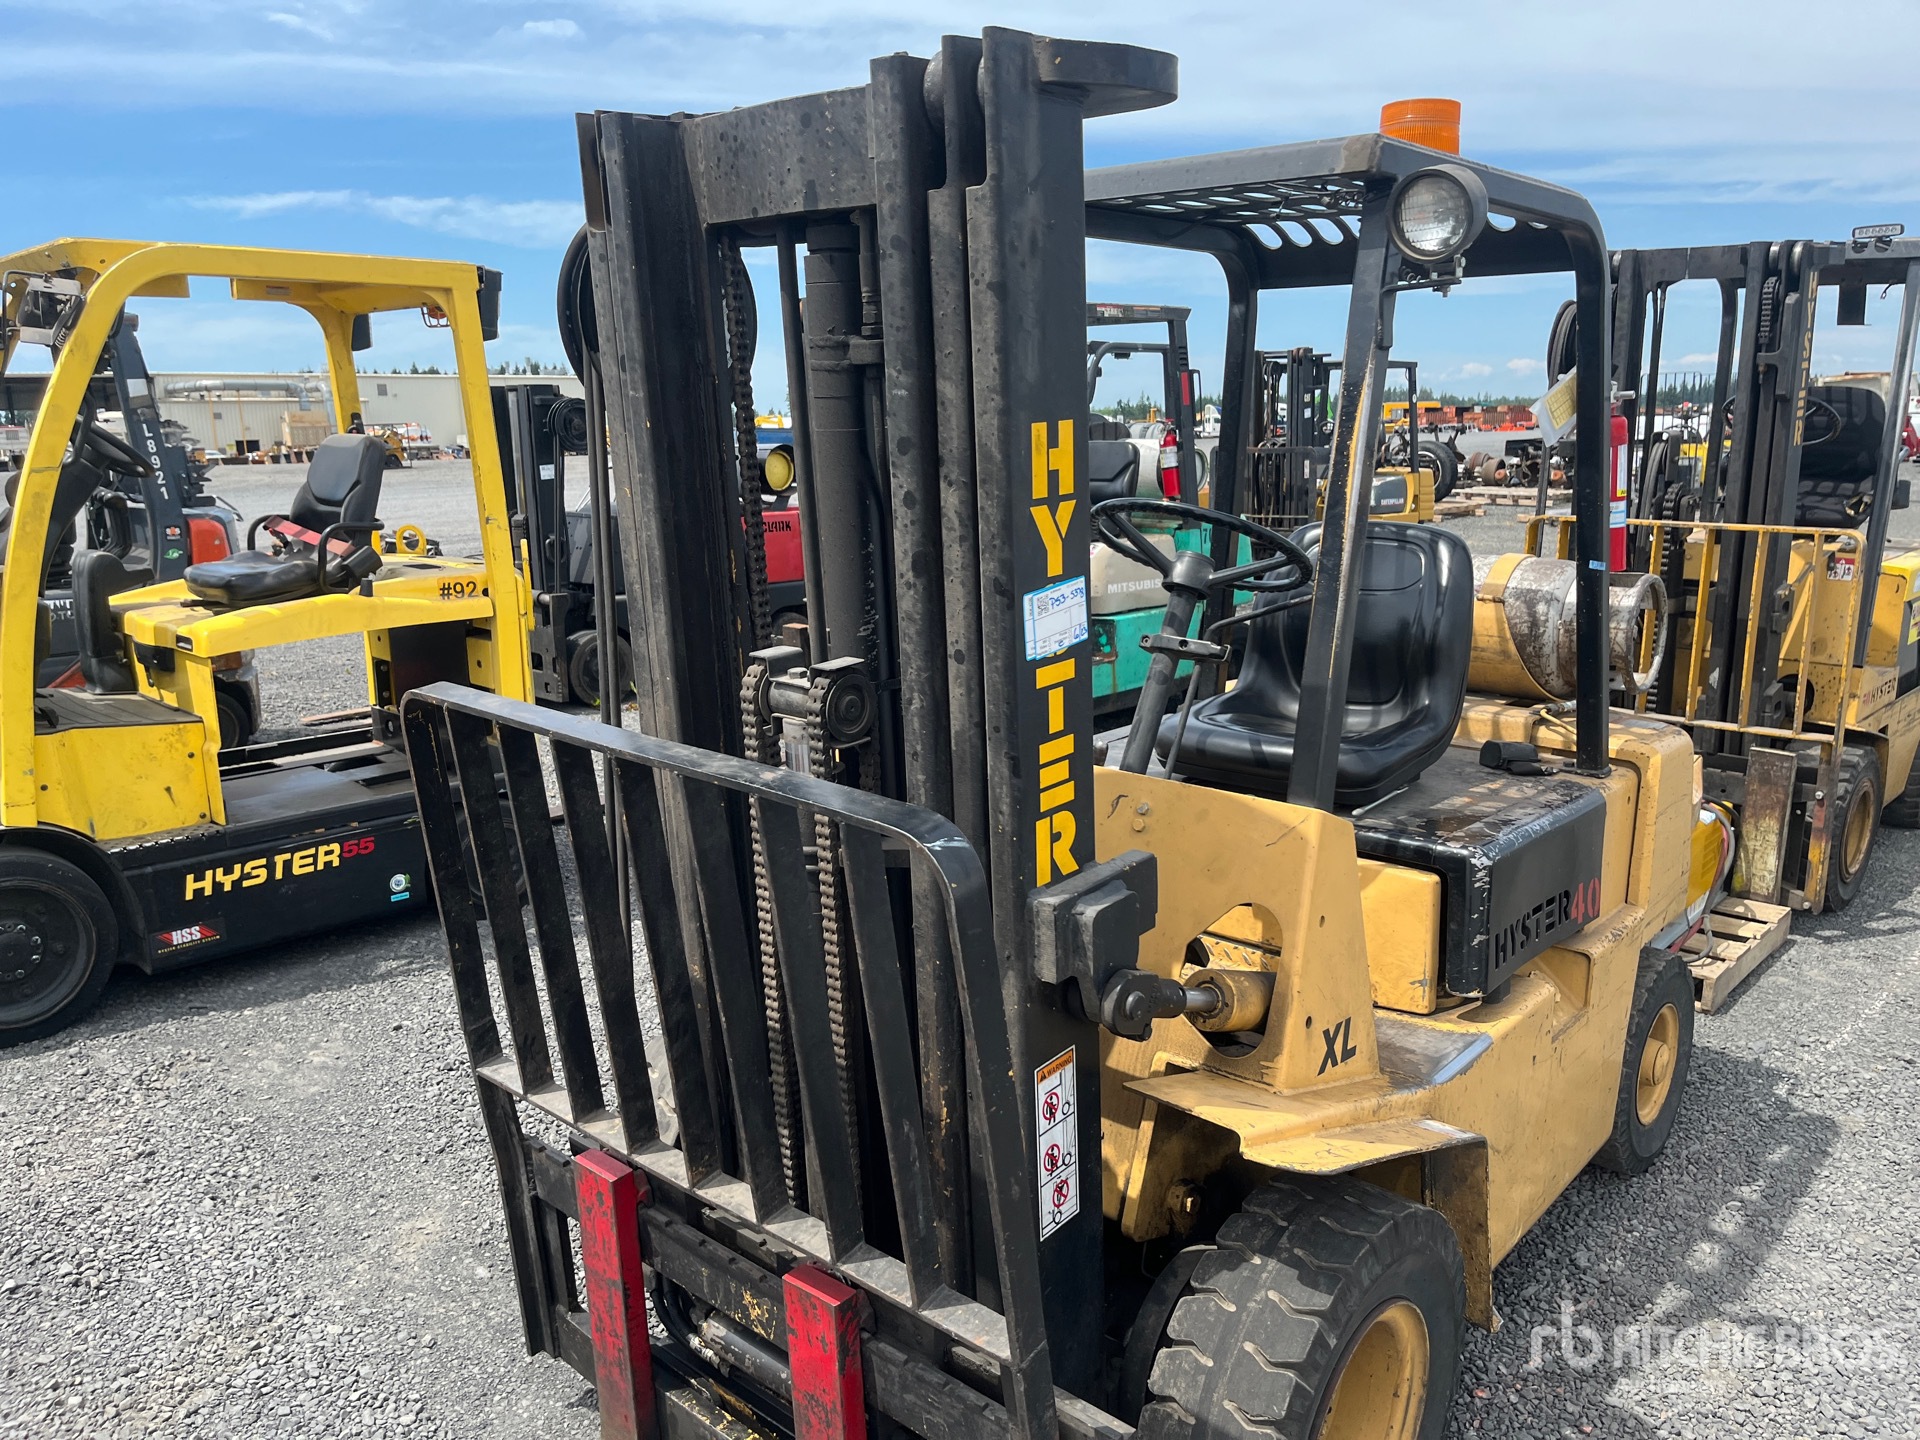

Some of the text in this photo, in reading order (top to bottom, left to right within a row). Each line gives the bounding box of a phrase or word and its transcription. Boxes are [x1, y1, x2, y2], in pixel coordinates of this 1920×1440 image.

[1793, 271, 1818, 447] HYSTER
[142, 423, 169, 500] L8921
[762, 520, 792, 533] CLARK
[439, 580, 479, 600] #92
[1107, 578, 1161, 594] MITSUBIS
[1030, 418, 1080, 888] HYTER
[185, 842, 342, 901] HYSTER
[342, 836, 375, 859] 55
[171, 925, 202, 946] HSS
[1494, 877, 1600, 970] HYSTER 40
[1046, 1055, 1072, 1078] WARNING
[1316, 1015, 1357, 1077] XL
